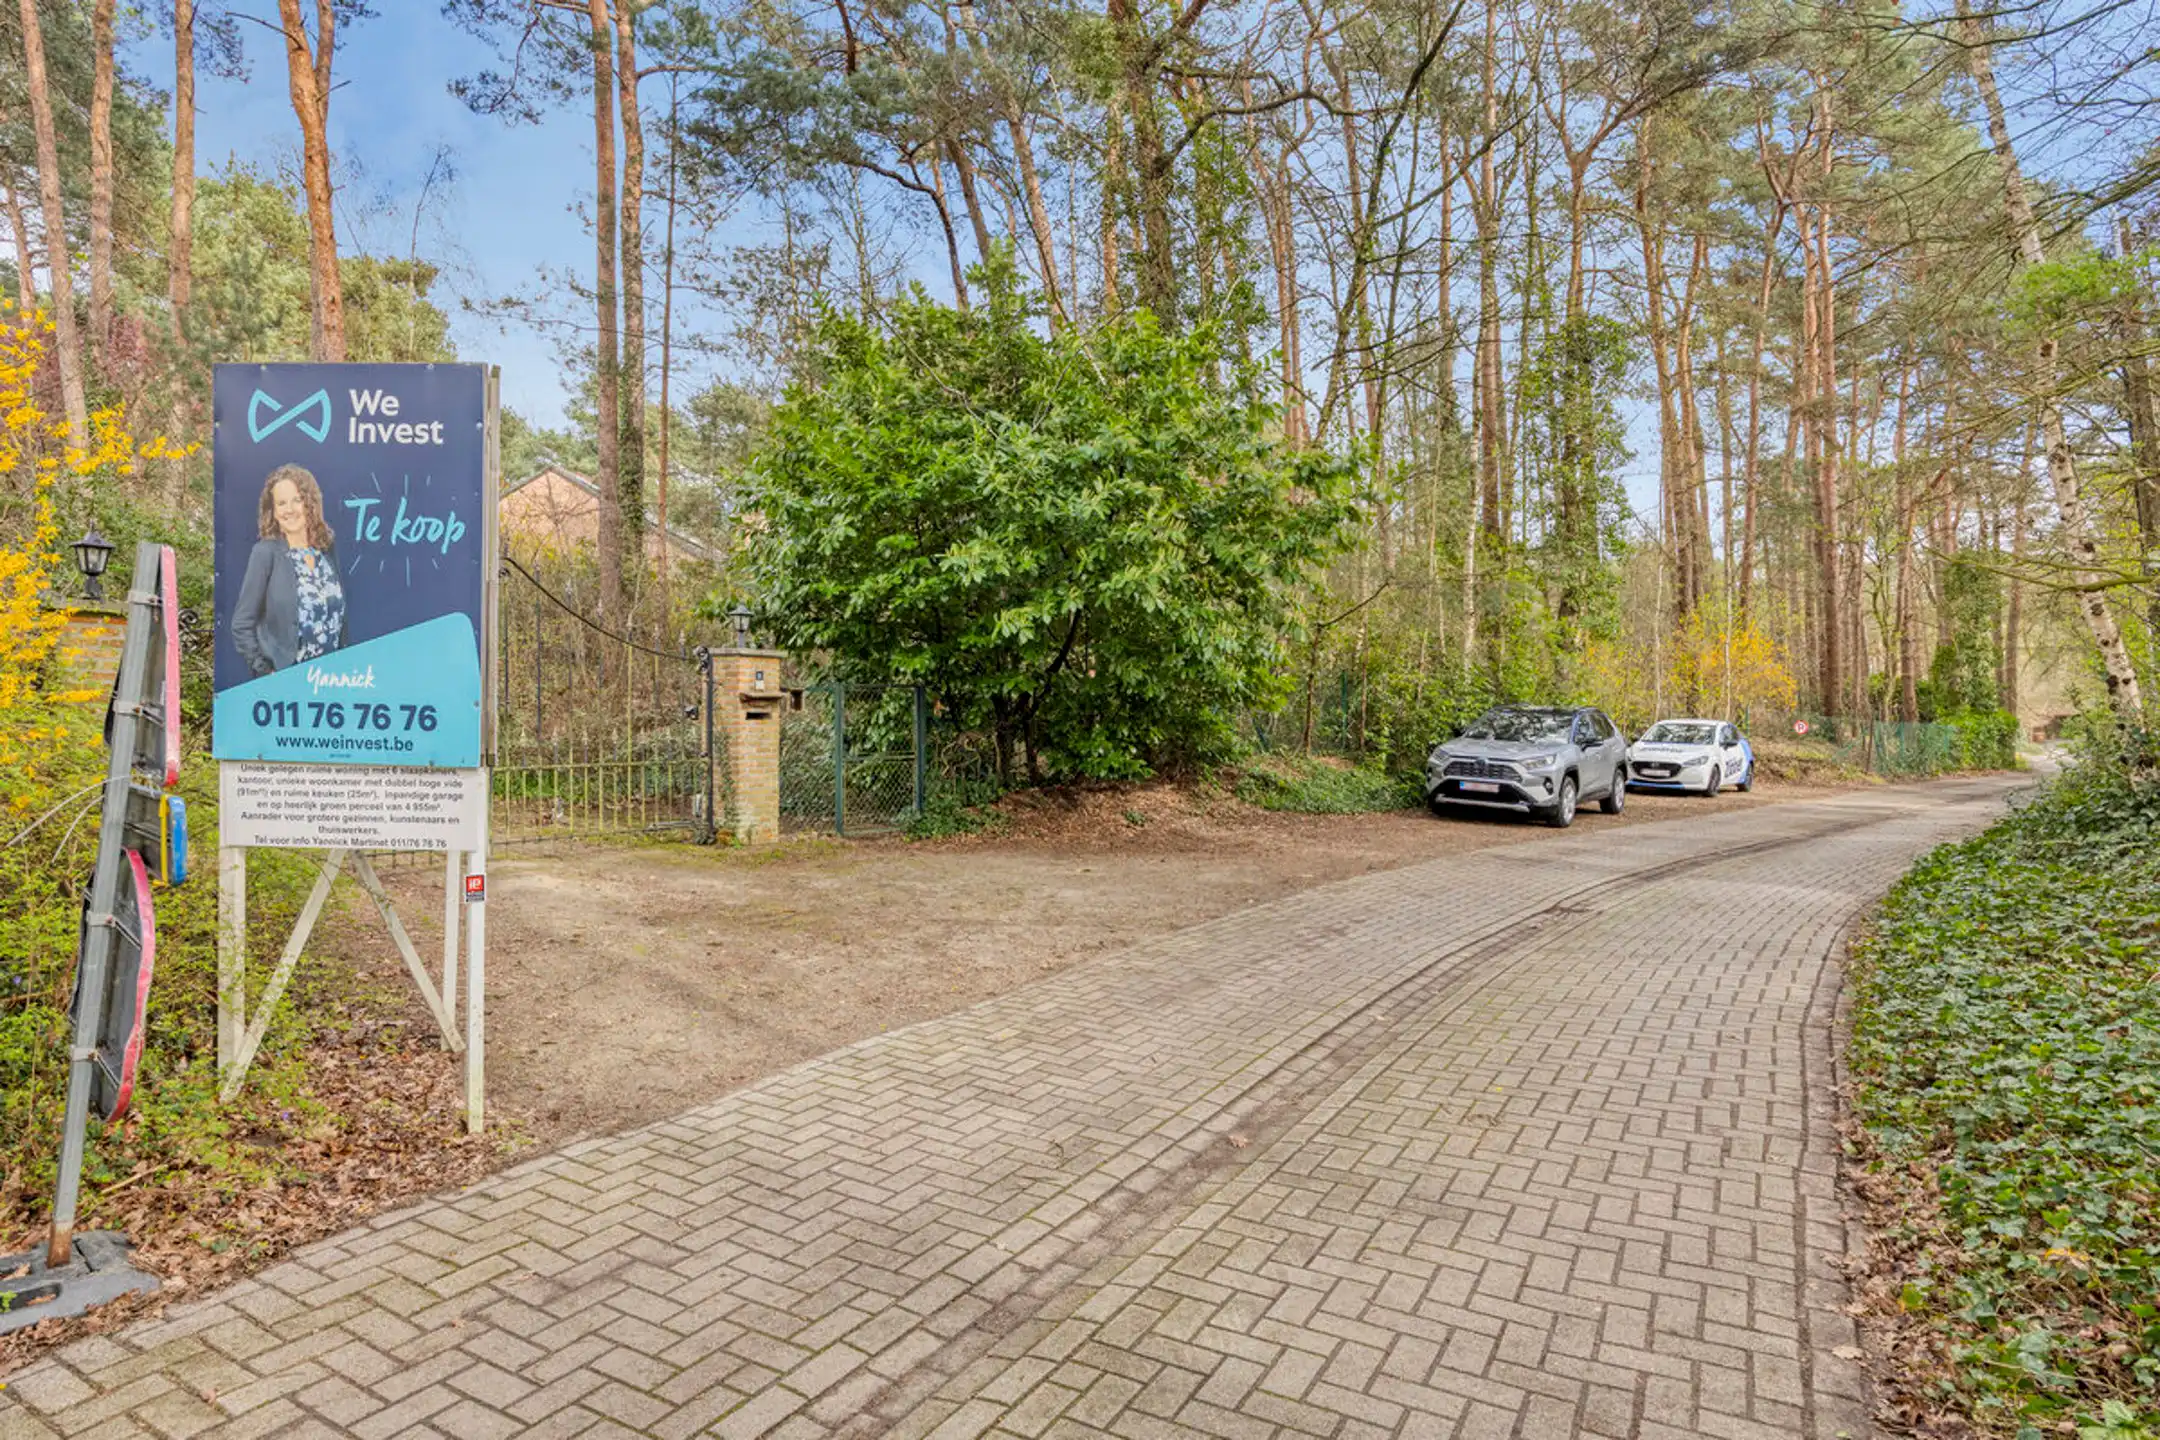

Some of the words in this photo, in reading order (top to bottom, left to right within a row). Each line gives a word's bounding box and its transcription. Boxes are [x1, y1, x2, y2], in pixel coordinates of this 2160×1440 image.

[349, 388, 400, 416] We
[349, 417, 444, 444] Invest
[343, 497, 382, 542] Te
[391, 496, 466, 555] koop
[306, 665, 376, 695] Yannick
[252, 700, 300, 727] 011
[307, 702, 345, 730] 76
[353, 703, 391, 731] 76
[399, 704, 438, 732] 76
[275, 735, 414, 751] www.weinvest.be
[268, 764, 304, 775] gelegen
[372, 766, 390, 775] met
[276, 776, 306, 786] unieke
[308, 777, 362, 787] woonkamer
[364, 778, 382, 787] met
[385, 778, 416, 788] dubbel
[419, 780, 441, 789] hoge
[444, 780, 463, 788] vide
[270, 789, 282, 797] en
[284, 788, 310, 798] ruime
[312, 790, 345, 798] keuken
[432, 792, 464, 802] garage
[256, 802, 268, 810] en
[270, 802, 282, 812] op
[284, 801, 318, 811] heerlijk
[320, 803, 347, 812] groen
[349, 803, 384, 814] perceel
[386, 804, 402, 812] van
[241, 812, 282, 822] Aanrader
[284, 813, 305, 822] voor
[306, 814, 340, 824] grotere
[390, 814, 446, 824] kunstenaars
[448, 816, 460, 824] en
[318, 826, 381, 835] thuiswerkers.
[254, 835, 266, 844] Tel
[269, 836, 290, 844] voor
[292, 836, 310, 845] info
[312, 836, 348, 846] Yannick
[436, 839, 448, 848] 76
